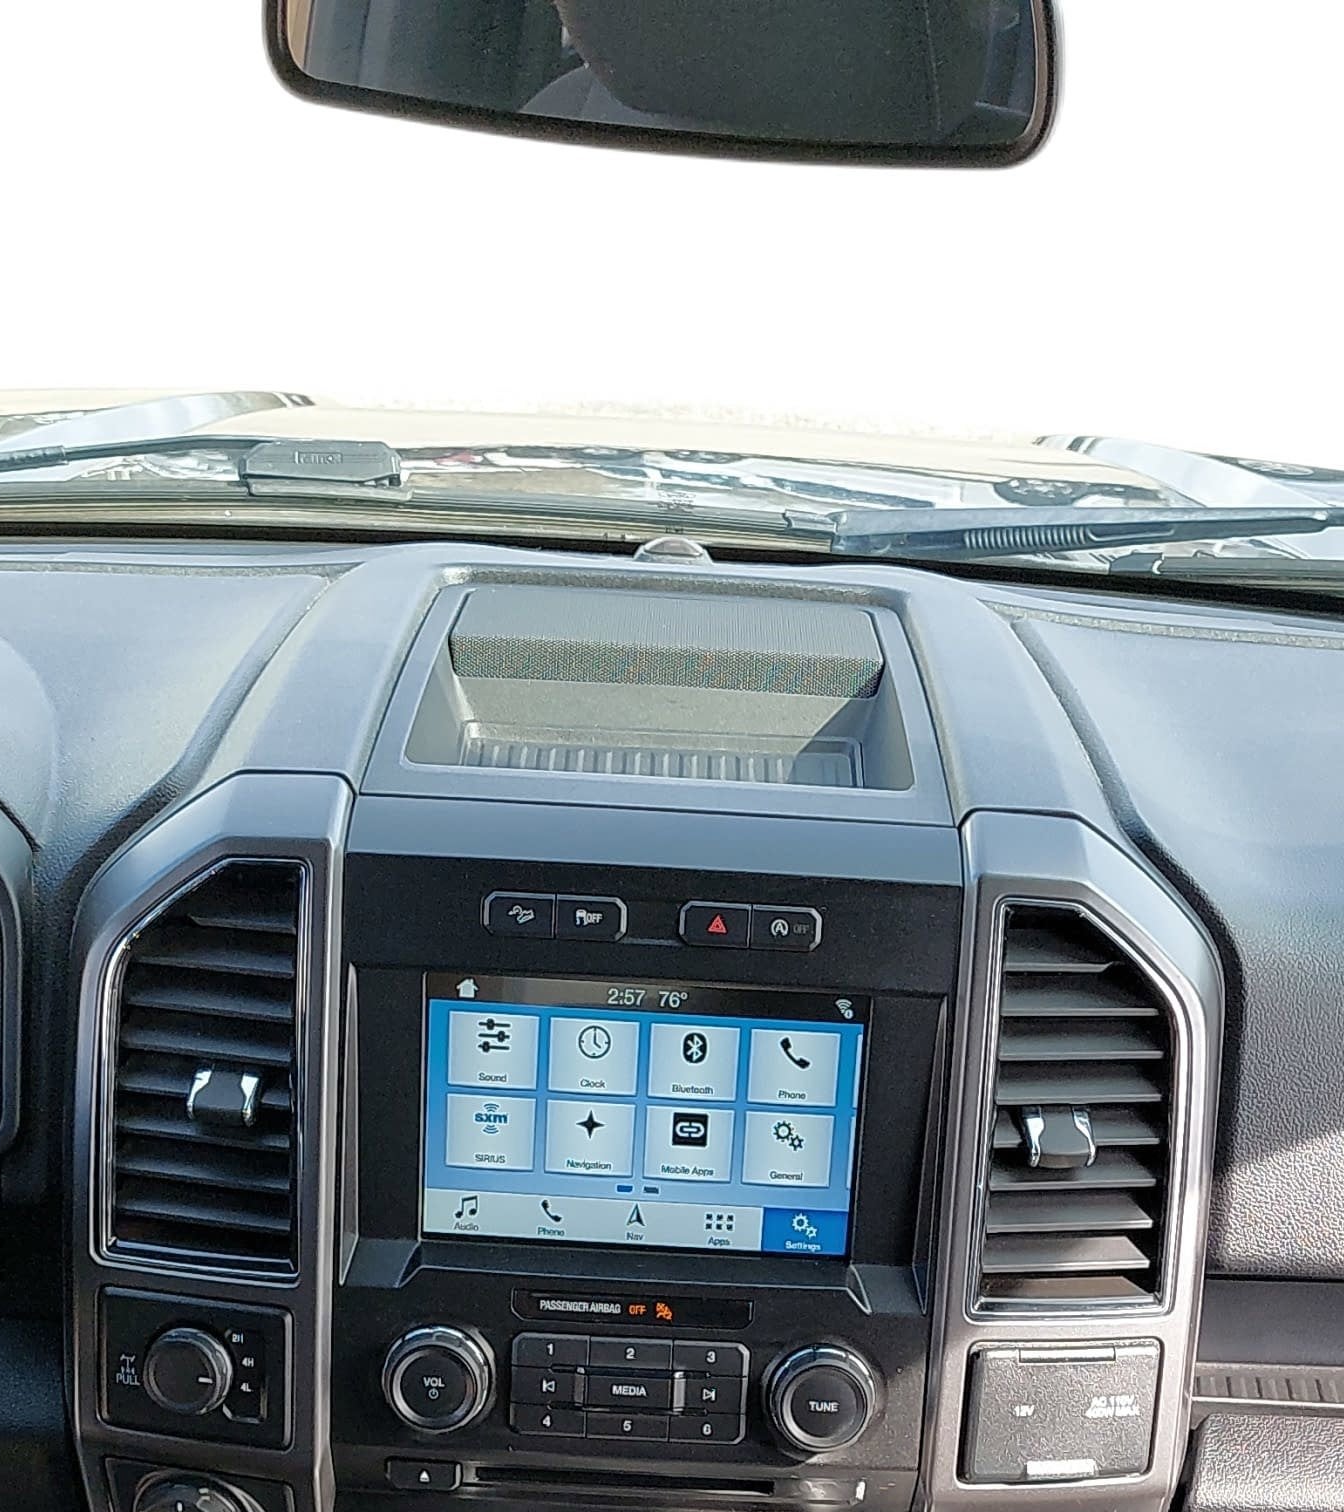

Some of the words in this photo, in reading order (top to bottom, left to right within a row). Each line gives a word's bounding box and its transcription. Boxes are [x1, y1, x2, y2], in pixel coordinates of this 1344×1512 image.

[585, 913, 604, 925] OFF
[607, 988, 646, 1007] 2:57
[477, 1071, 508, 1083] Sound
[579, 1077, 607, 1090] Clock
[671, 1083, 714, 1096] Bluetooth
[777, 1089, 807, 1101] Phone
[474, 1153, 506, 1165] SIRIUS
[566, 1159, 612, 1172] Navigation
[661, 1164, 689, 1176] Mobile
[690, 1166, 715, 1178] Apps
[769, 1170, 803, 1182] General
[453, 1221, 479, 1233] Audio
[537, 1225, 565, 1237] Phone
[626, 1230, 644, 1241] Nav
[707, 1235, 731, 1247] Apps
[785, 1239, 822, 1253] Settings
[539, 1299, 589, 1313] PASSENGER
[590, 1301, 622, 1314] AIRBAG
[628, 1304, 647, 1316] OFF
[546, 1343, 554, 1354] 1
[625, 1347, 636, 1360] 2
[241, 1356, 255, 1368] 4H
[706, 1351, 716, 1364] 3
[116, 1372, 141, 1387] PULL
[423, 1376, 445, 1388] VOL
[239, 1382, 252, 1392] 4L
[612, 1385, 647, 1397] MEDIA
[809, 1400, 840, 1413] TUNE
[542, 1415, 551, 1427] 4
[623, 1420, 632, 1431] 5
[702, 1423, 712, 1435] 6
